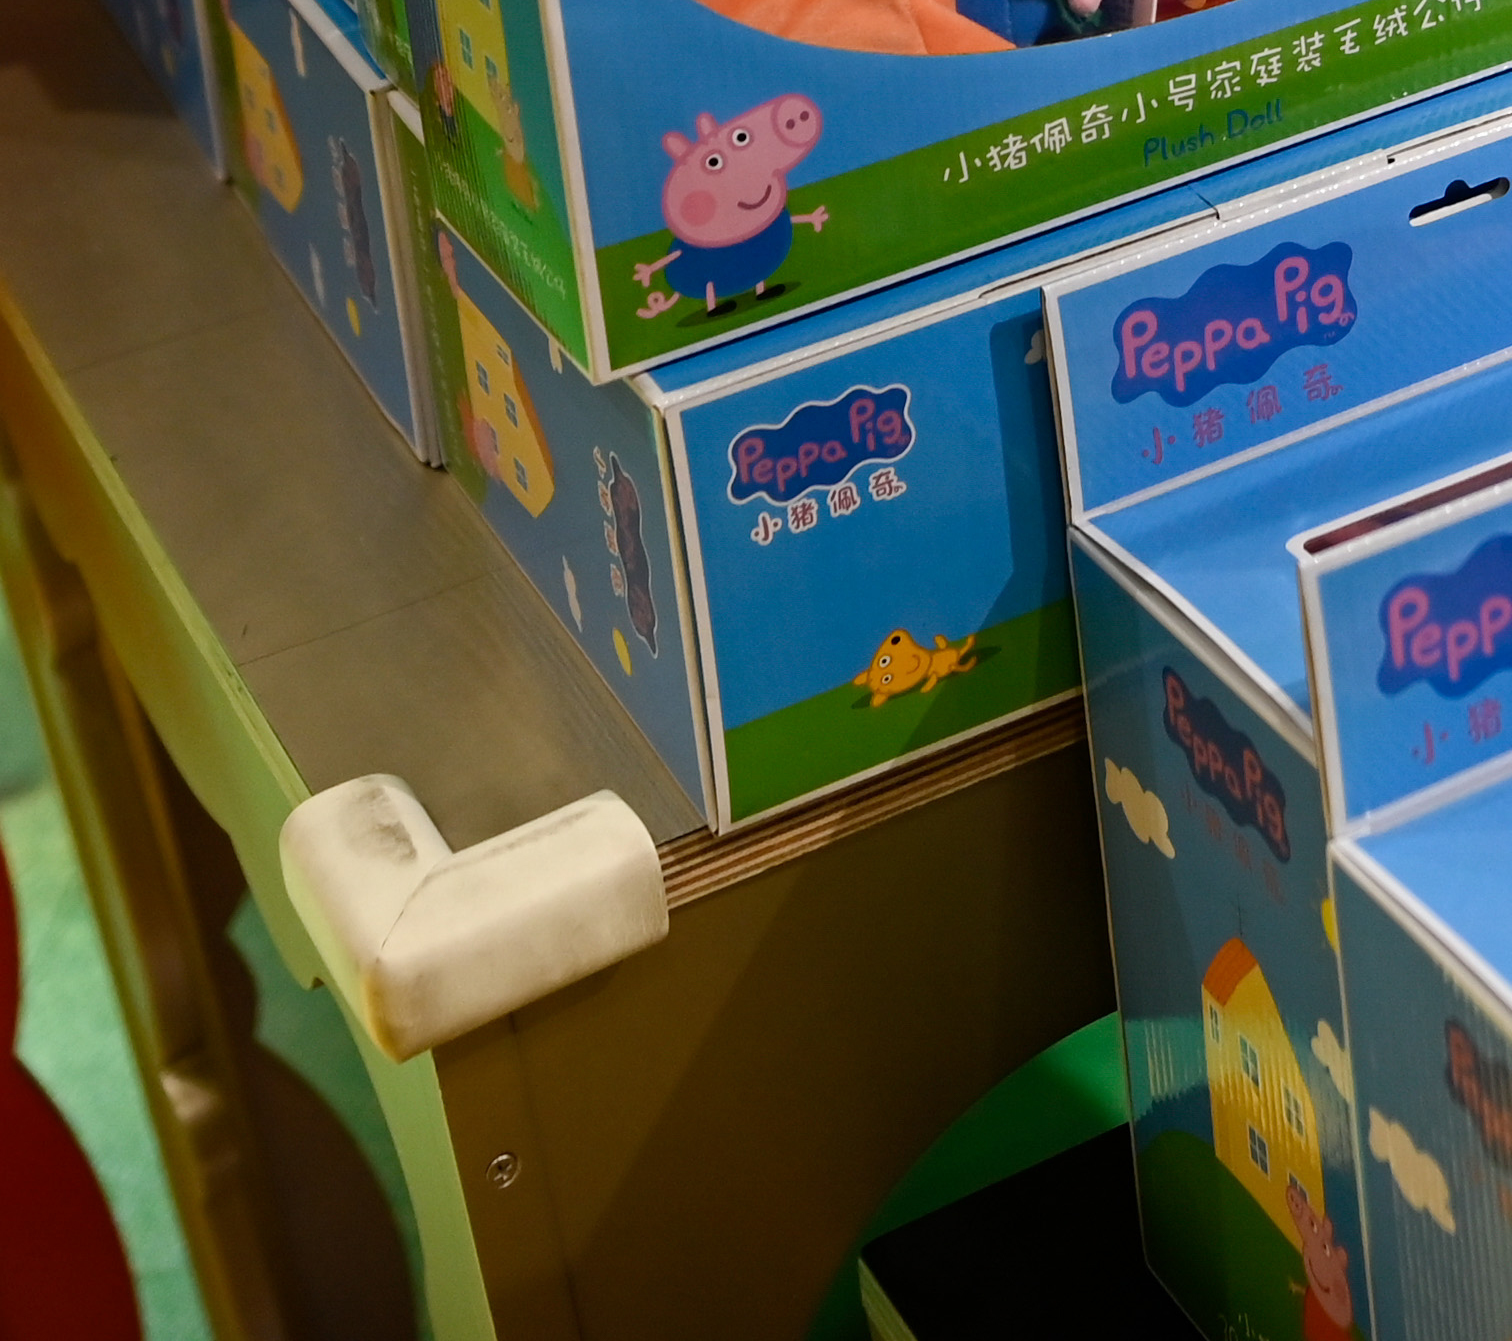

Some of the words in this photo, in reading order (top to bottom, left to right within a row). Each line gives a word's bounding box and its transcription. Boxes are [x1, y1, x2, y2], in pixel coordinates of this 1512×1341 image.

[1143, 127, 1215, 167] Plush
[1226, 99, 1284, 140] Doll
[1120, 310, 1271, 392] Peppa
[1273, 257, 1354, 335] Pig
[737, 436, 848, 493] Peppa
[849, 398, 911, 452] Pig
[1141, 364, 1343, 465] 小猪佩奇
[752, 469, 906, 545] 小猪佩奇
